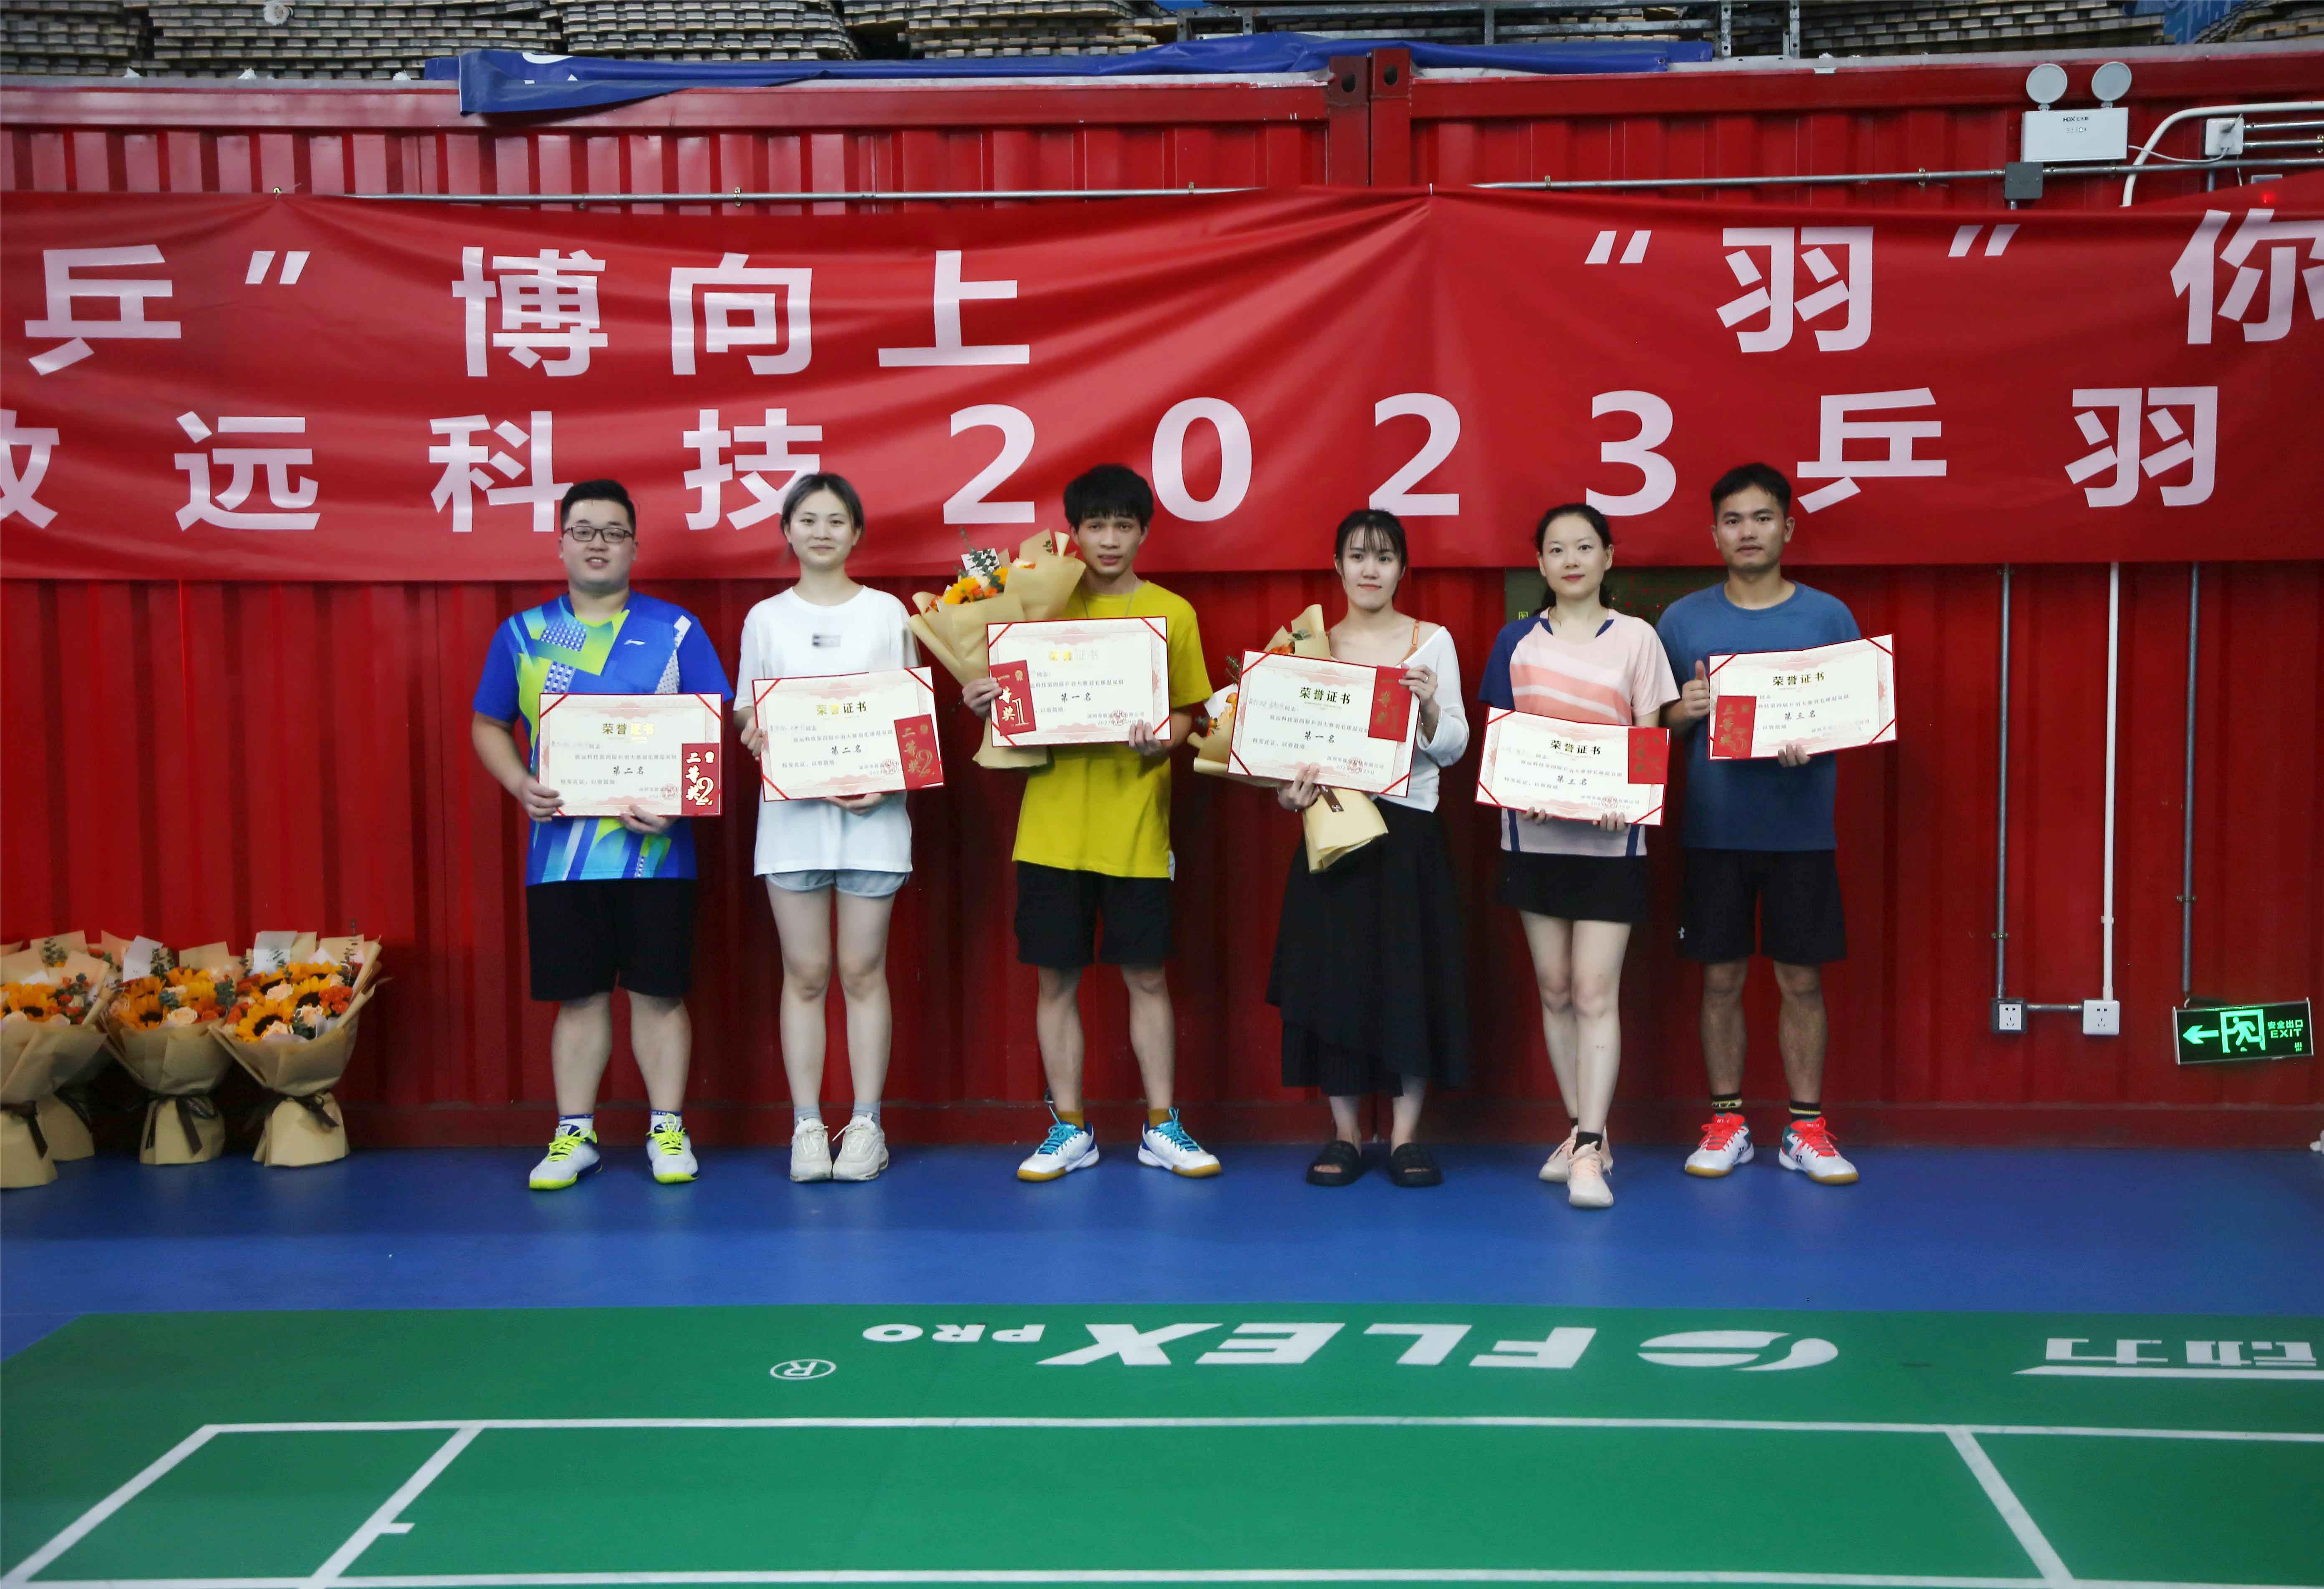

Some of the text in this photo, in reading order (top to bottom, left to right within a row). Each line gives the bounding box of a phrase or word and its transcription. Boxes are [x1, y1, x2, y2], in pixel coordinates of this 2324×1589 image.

[1773, 672, 1824, 686] 荣誉证书
[1061, 693, 1092, 702] 第一名
[1299, 687, 1351, 705] 荣誉证书
[816, 701, 866, 715] 荣誉证书
[1784, 710, 1816, 720] 第三名
[1305, 731, 1335, 743] 第一名
[831, 745, 862, 755] 第二名
[1550, 740, 1601, 755] 荣誉证书
[612, 765, 645, 776] 第二名
[1557, 775, 1587, 786] 第三名
[2268, 1019, 2303, 1029] 安全出口
[2271, 1028, 2301, 1038] EXIT
[862, 1324, 1046, 1342] PRO
[1037, 1322, 1598, 1370] FLEX
